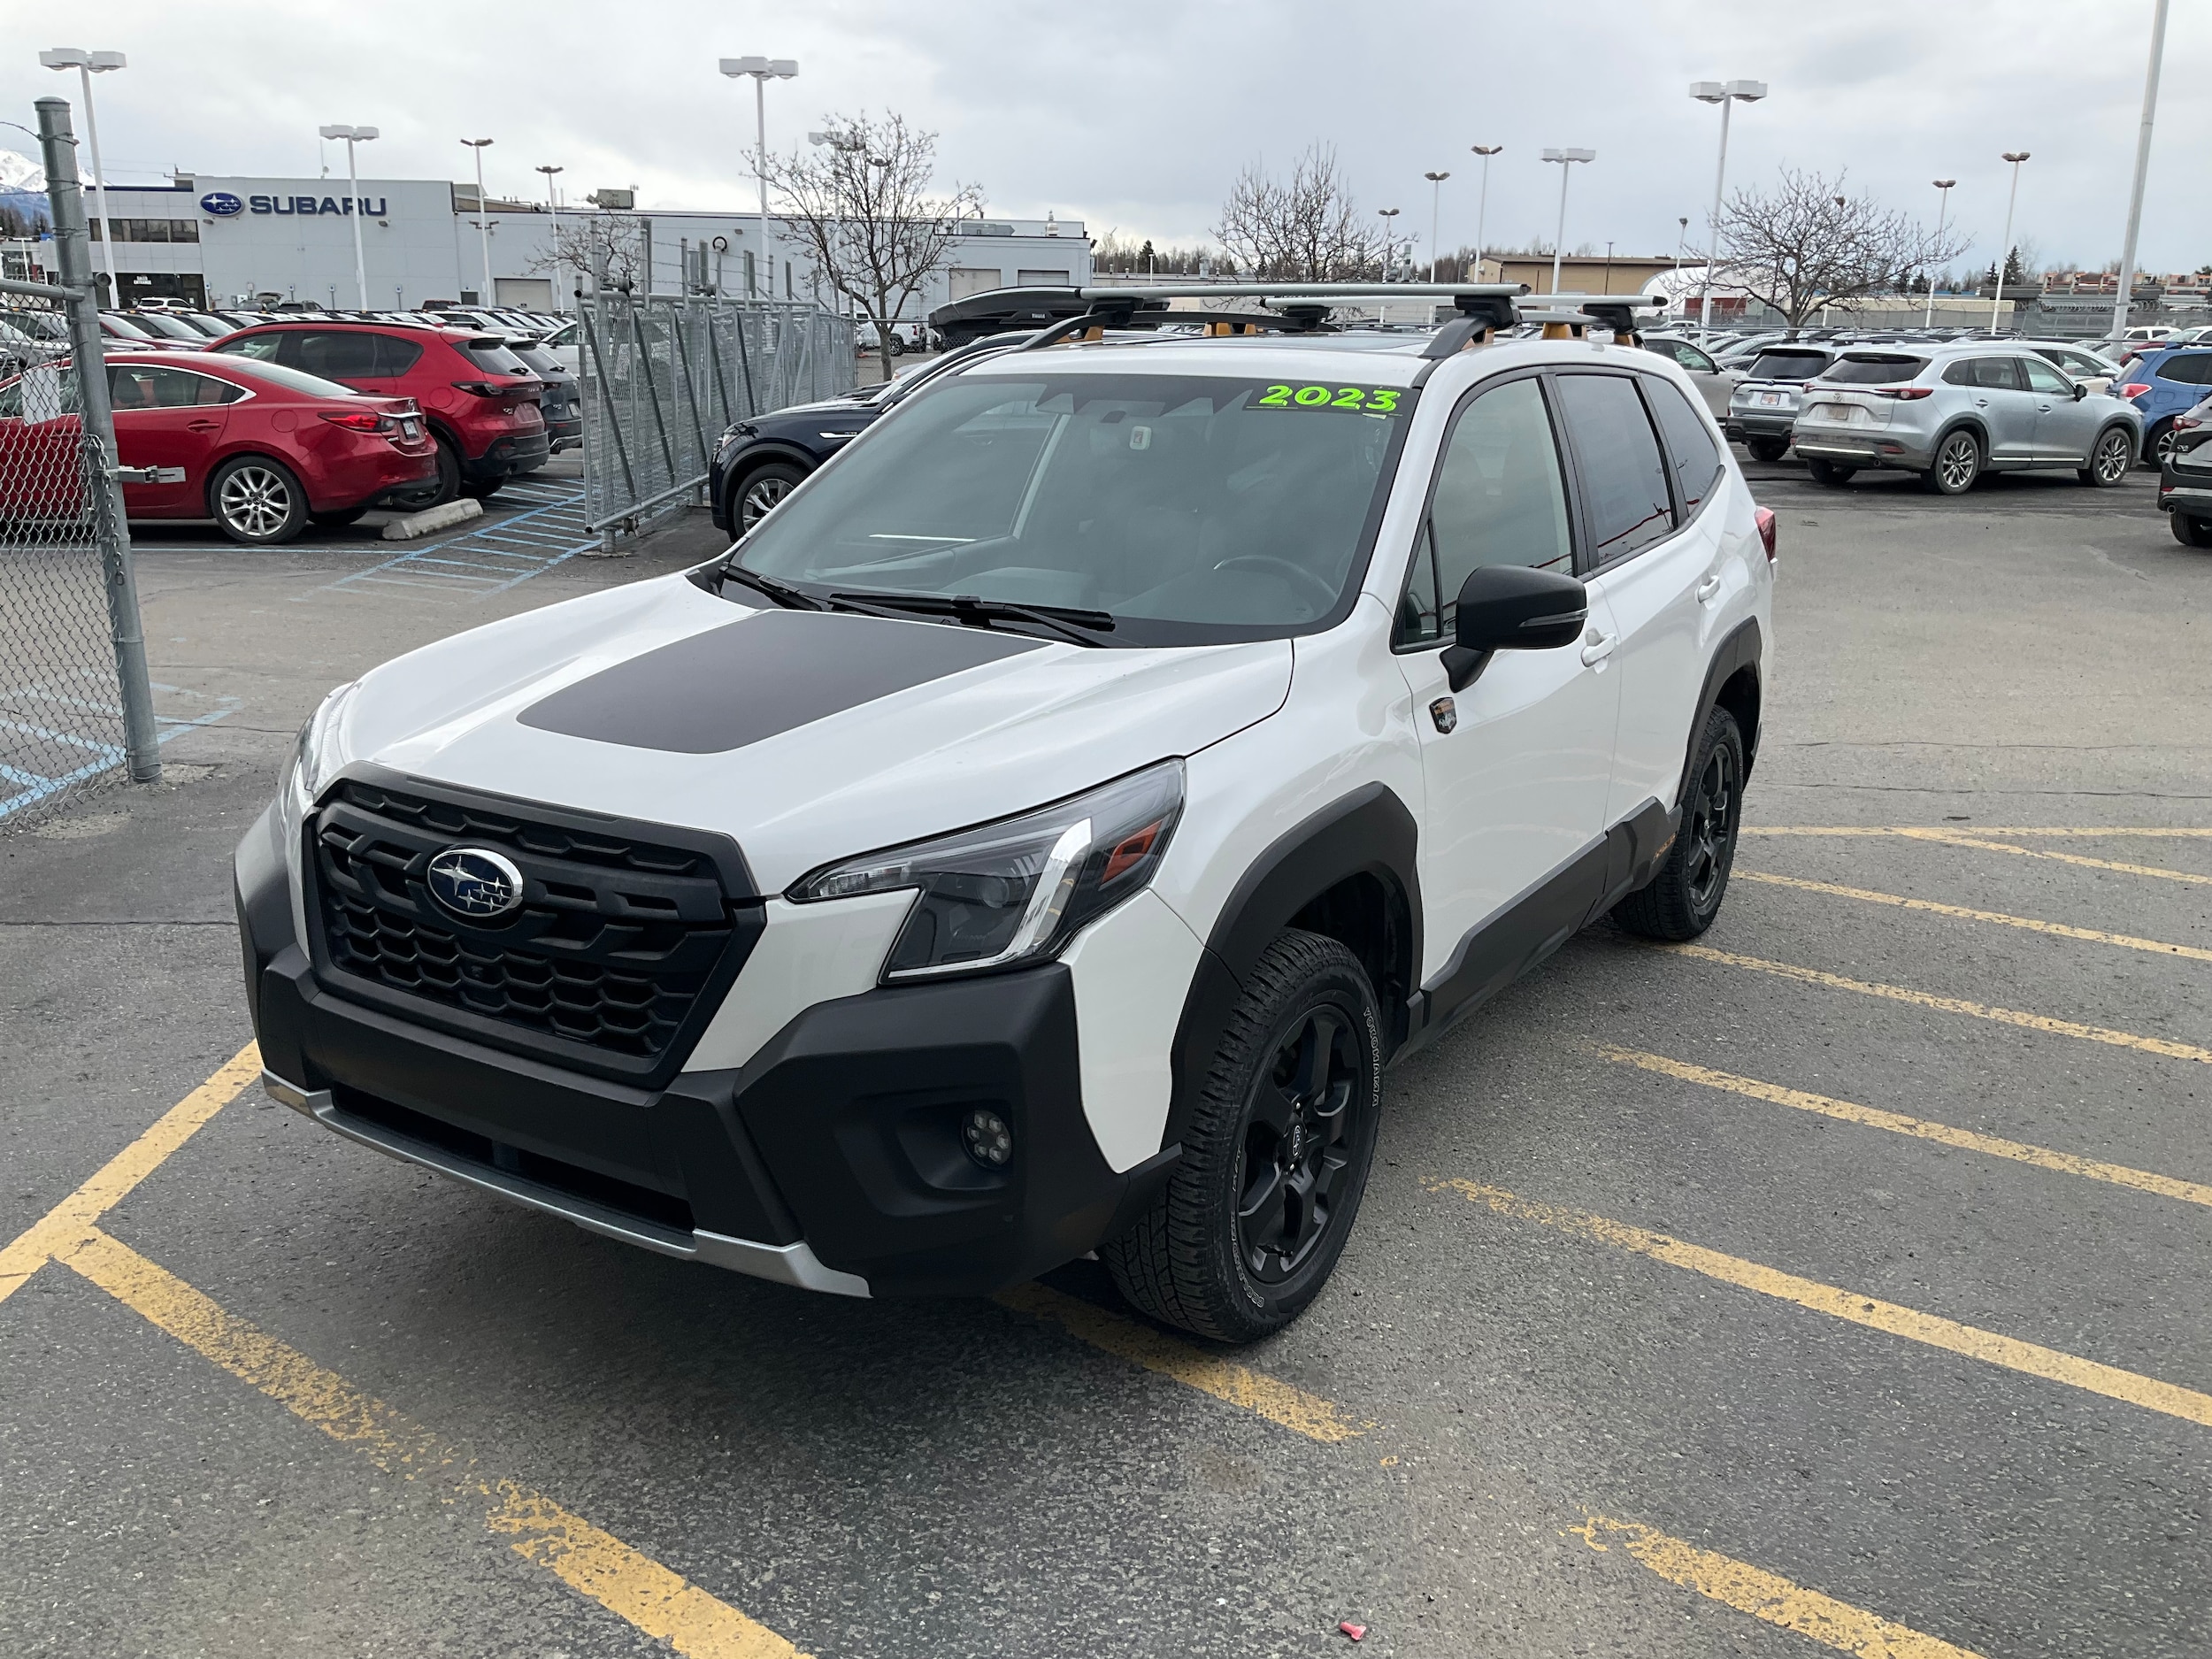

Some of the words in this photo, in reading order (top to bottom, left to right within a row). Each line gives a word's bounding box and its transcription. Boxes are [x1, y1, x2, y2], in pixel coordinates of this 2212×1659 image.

[249, 196, 388, 217] SUBARU
[1259, 385, 1401, 412] 2023
[1363, 1006, 1380, 1108] YOKOHAMA
